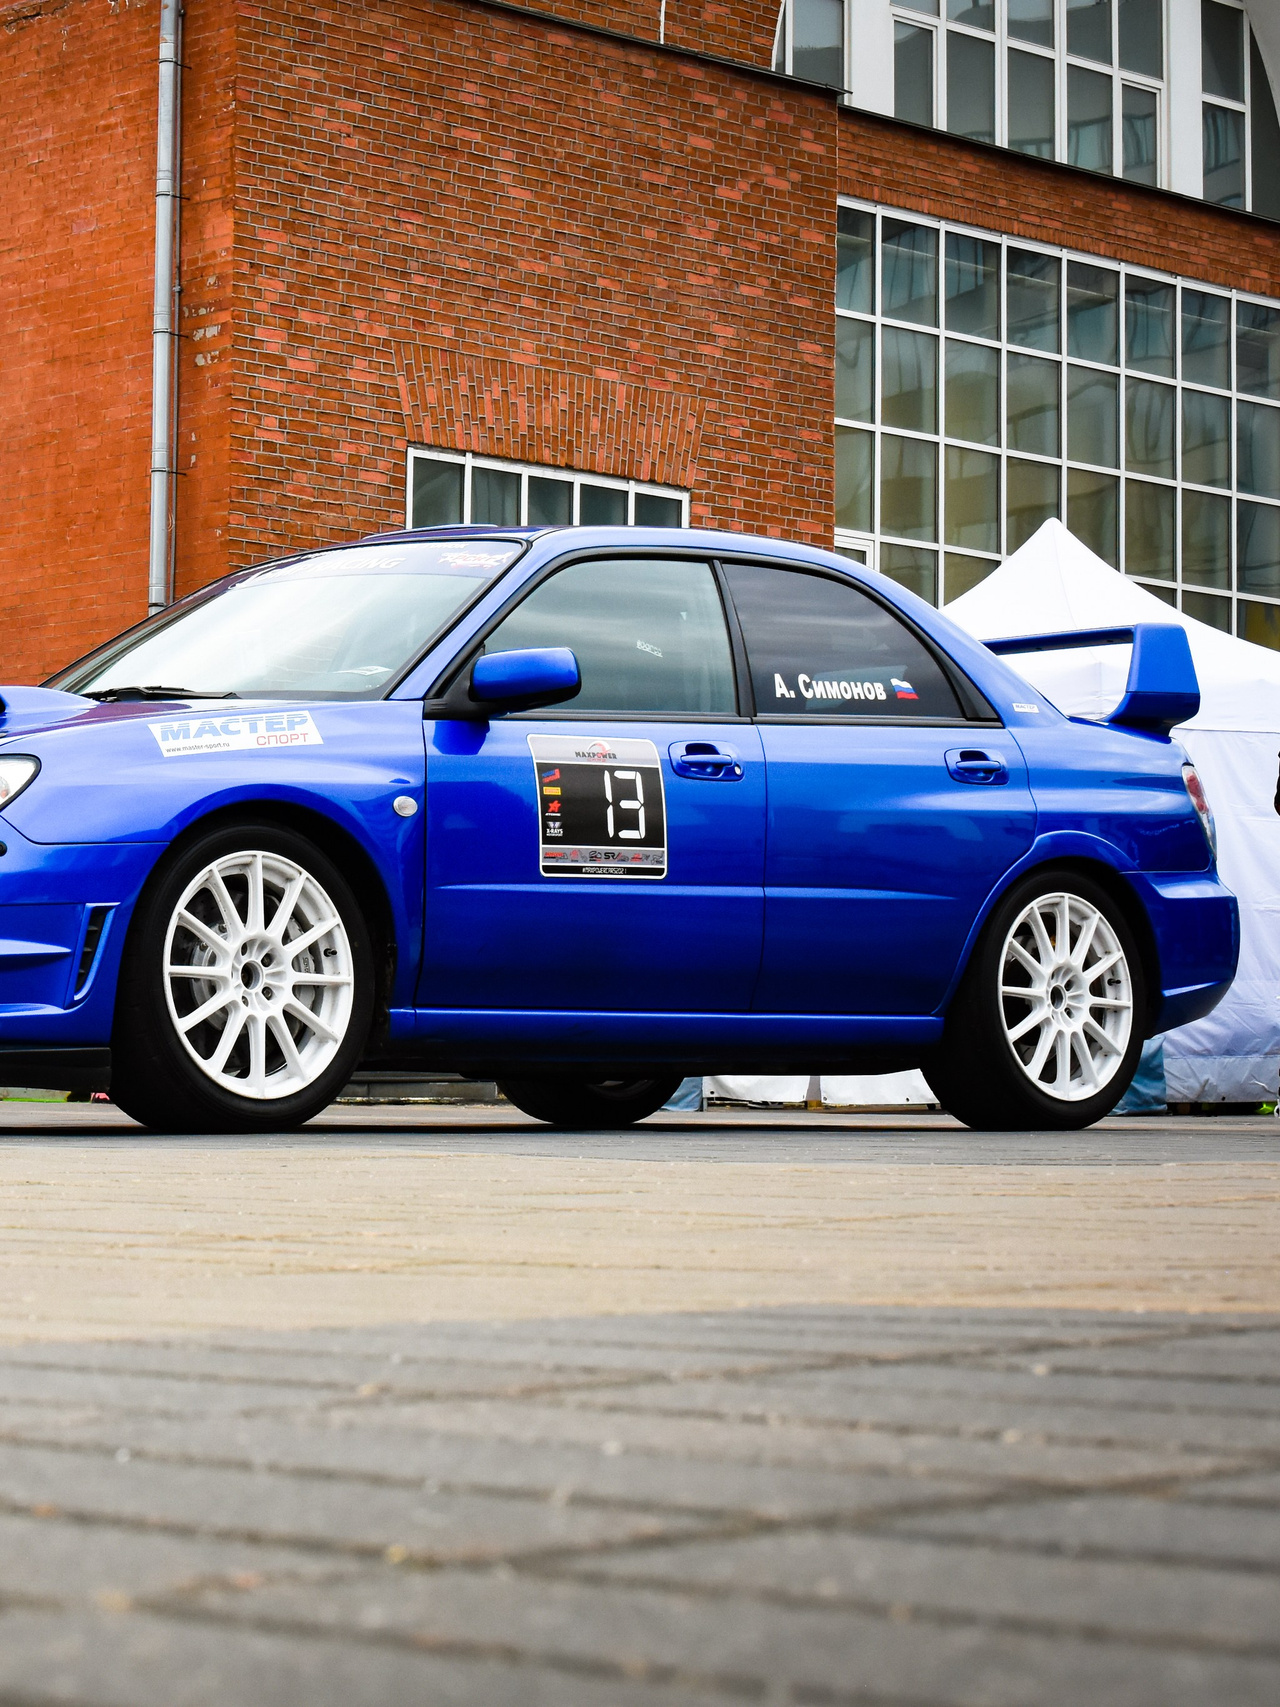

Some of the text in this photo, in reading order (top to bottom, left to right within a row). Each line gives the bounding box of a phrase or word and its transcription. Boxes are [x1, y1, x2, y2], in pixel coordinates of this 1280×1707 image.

[774, 673, 796, 698] А.
[160, 713, 309, 742] МАСТЕР
[257, 733, 309, 746] СПОРТ
[166, 742, 230, 753] www.master-sport.ru
[604, 770, 645, 839] 13
